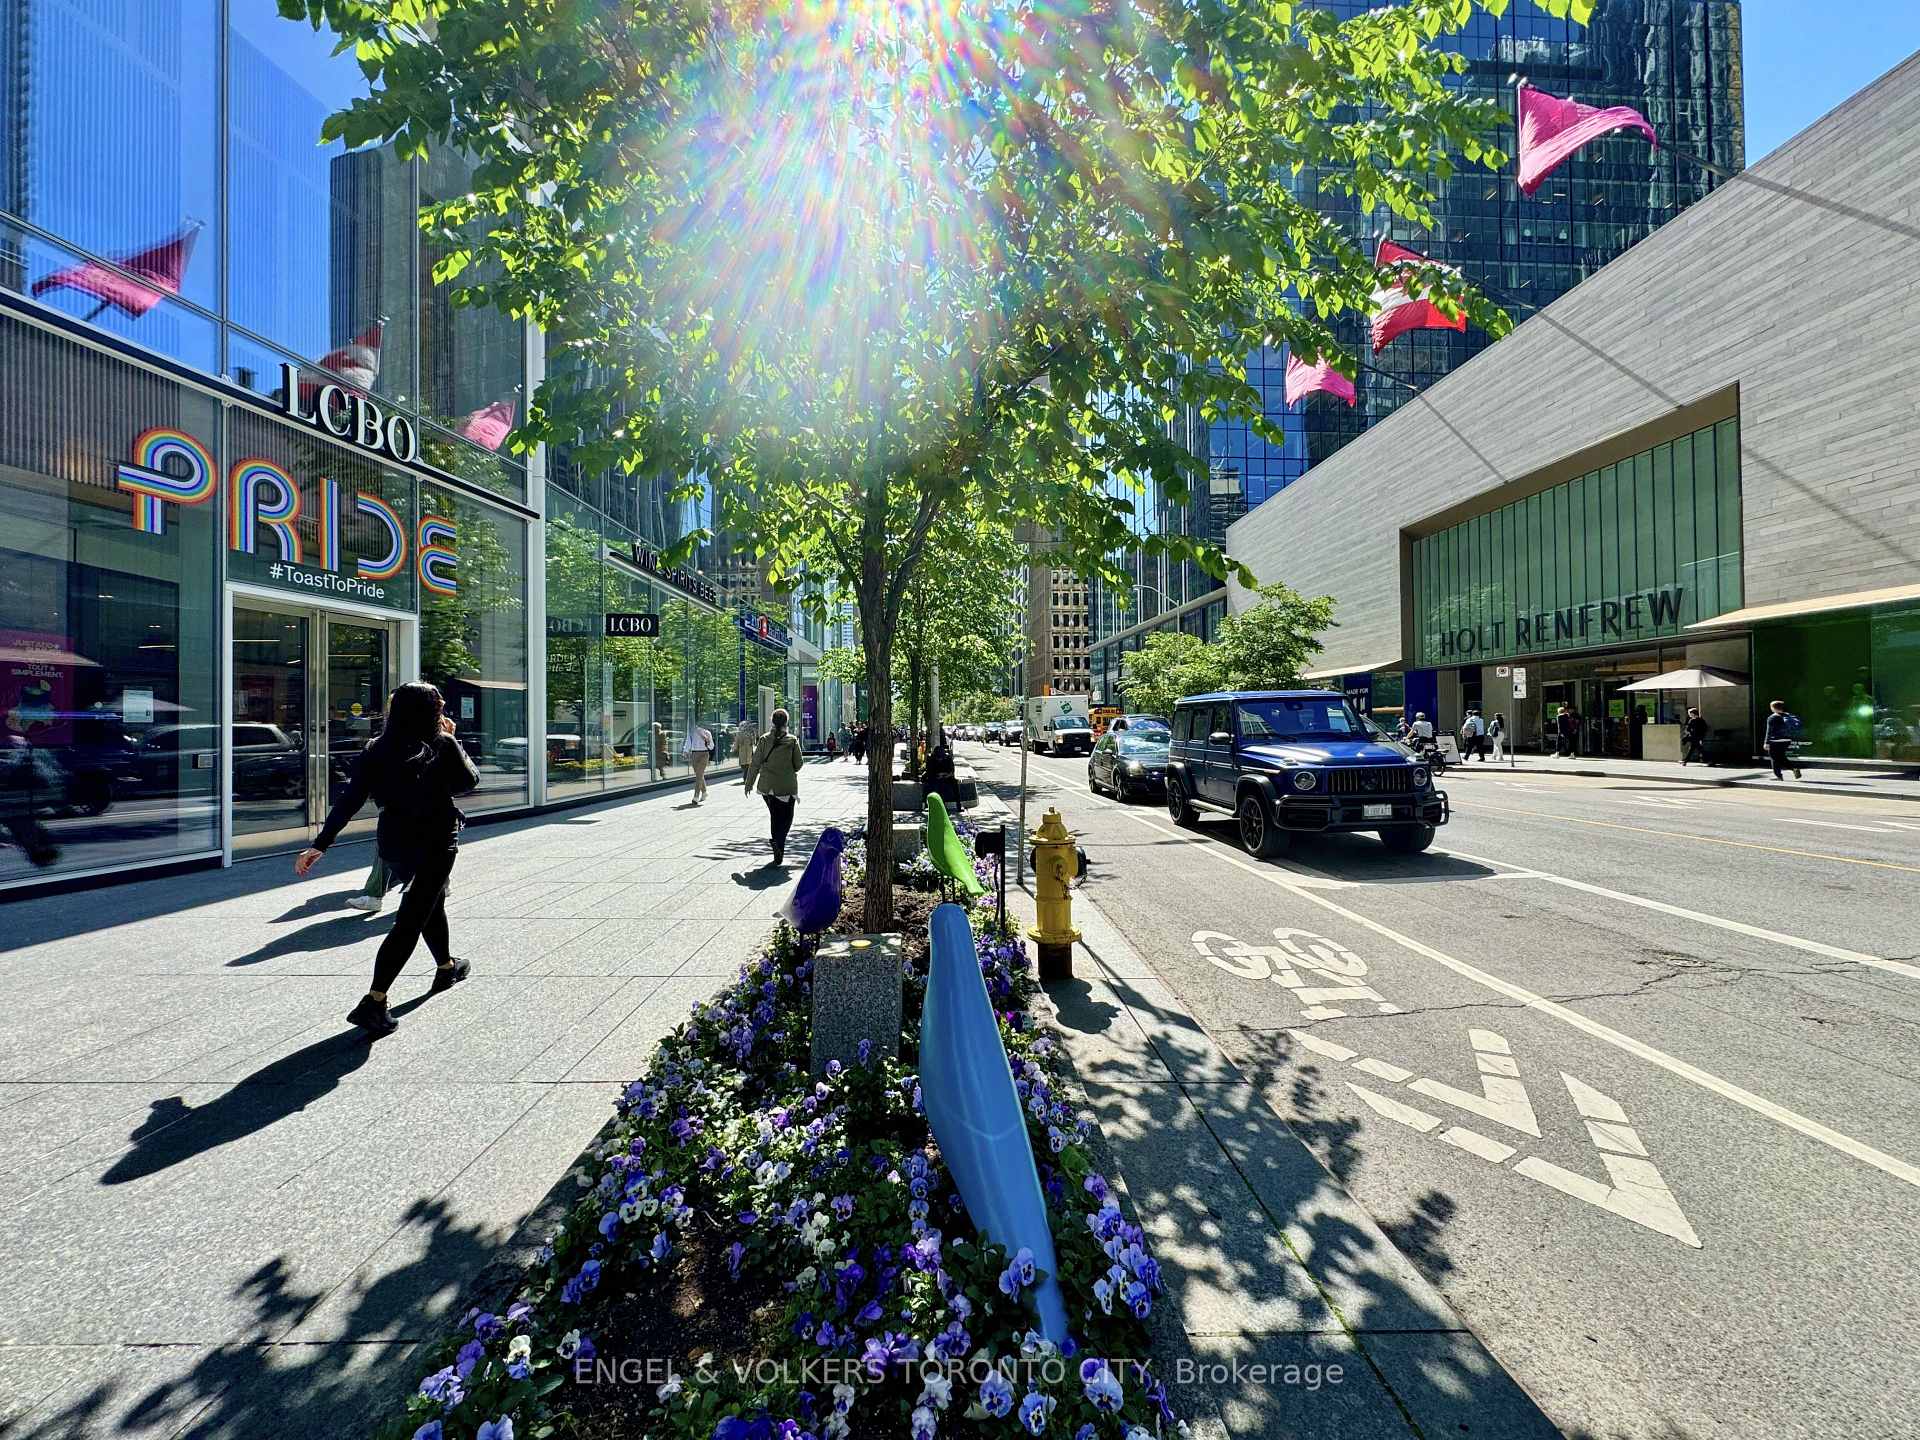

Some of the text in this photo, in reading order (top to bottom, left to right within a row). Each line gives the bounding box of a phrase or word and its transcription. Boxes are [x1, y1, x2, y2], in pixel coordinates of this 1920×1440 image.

[281, 363, 416, 462] LCBO
[118, 426, 456, 595] PRIDE
[269, 562, 385, 599] #ToastToPride
[635, 544, 666, 575] WIN
[610, 617, 652, 632] LCBO
[1441, 587, 1684, 656] HOLT RENFREW
